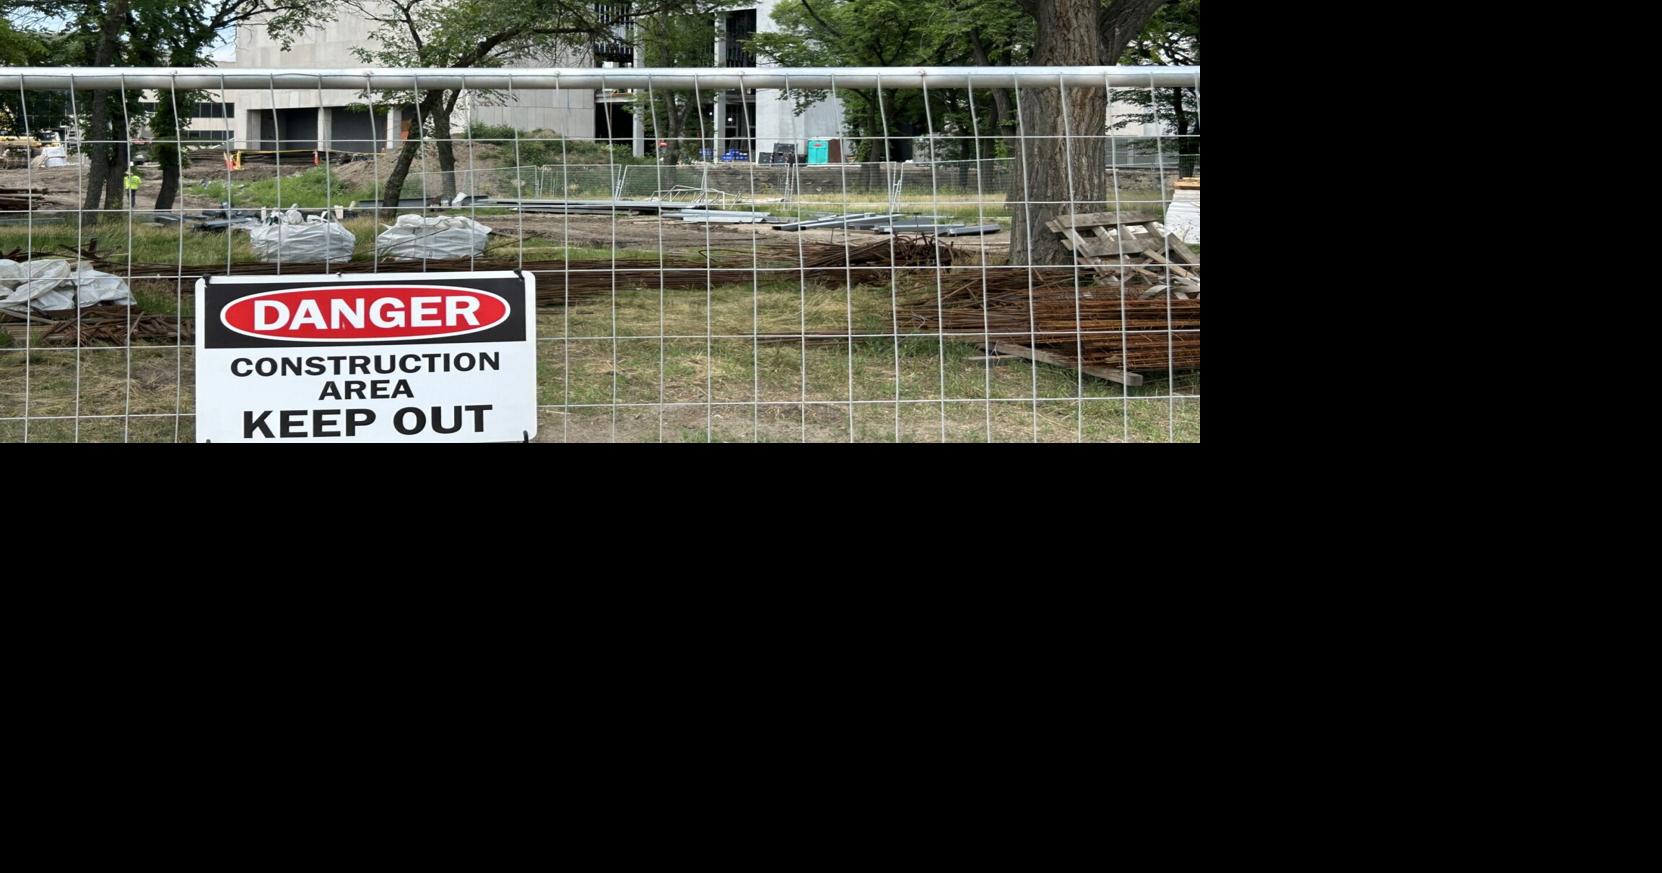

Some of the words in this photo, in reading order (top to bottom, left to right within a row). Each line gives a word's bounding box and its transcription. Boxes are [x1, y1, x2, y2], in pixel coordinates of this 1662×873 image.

[253, 295, 481, 331] DANGER
[230, 351, 500, 377] CONSTRUCTION
[318, 379, 415, 400] AREA
[243, 408, 377, 439] KEEP
[393, 404, 493, 435] OUT
